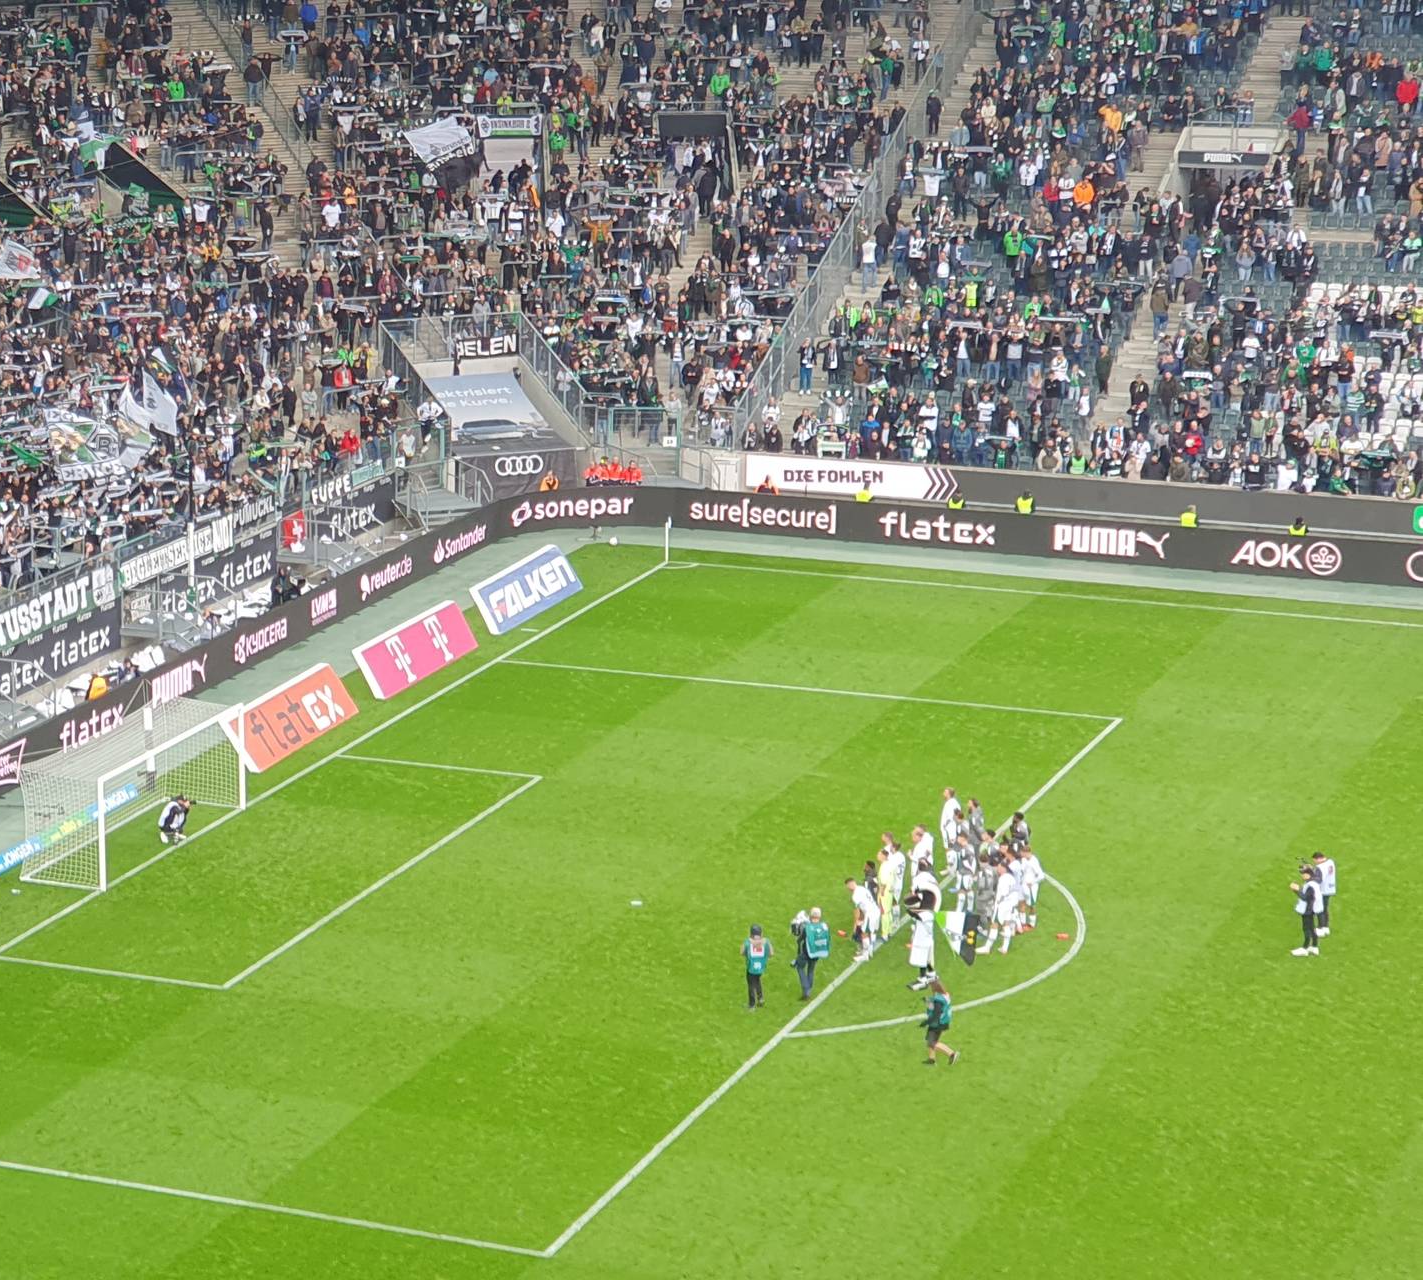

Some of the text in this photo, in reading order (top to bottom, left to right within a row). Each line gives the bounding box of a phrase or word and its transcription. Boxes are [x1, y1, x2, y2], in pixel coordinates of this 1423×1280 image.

[438, 387, 513, 399] ektrisiert
[784, 469, 884, 485] DIE FOHLEN
[534, 496, 634, 520] sonepar
[689, 499, 837, 535] sure[secure]
[444, 522, 487, 559] Santander
[879, 510, 997, 547] flatex
[1053, 524, 1139, 558] PUMA
[123, 527, 213, 588] BEGLEITSERICE
[221, 551, 272, 592] flatex
[370, 554, 413, 593] reuter.de
[1230, 539, 1304, 571] AOK
[162, 577, 217, 613] flaex
[488, 555, 577, 624] FALKEN
[51, 625, 112, 673] flatex
[244, 617, 288, 658] KYOCERA
[151, 661, 193, 709] PUMA
[60, 703, 124, 754] flatex
